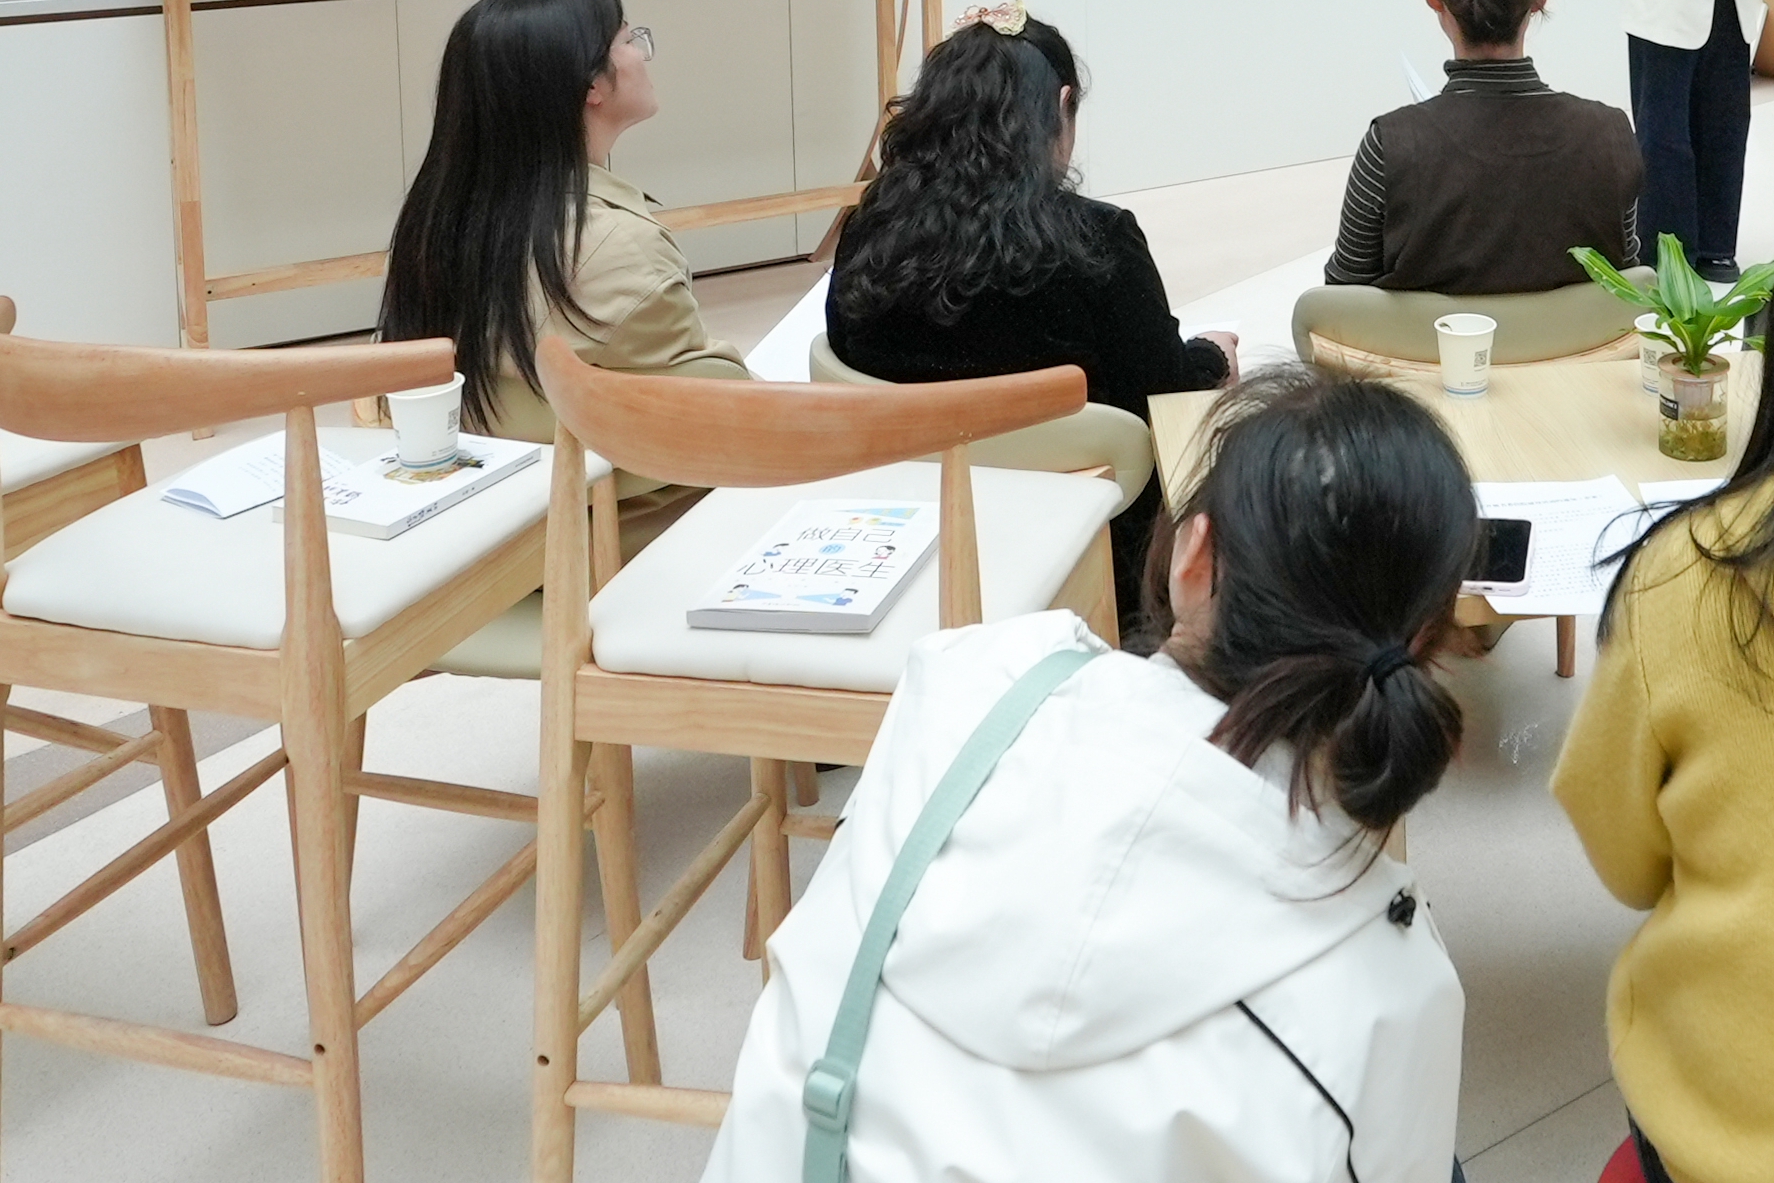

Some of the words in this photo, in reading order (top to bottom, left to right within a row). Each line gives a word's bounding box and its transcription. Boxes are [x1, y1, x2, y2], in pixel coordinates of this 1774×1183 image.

[796, 526, 896, 544] 做自己
[735, 557, 897, 580] 心理医生
